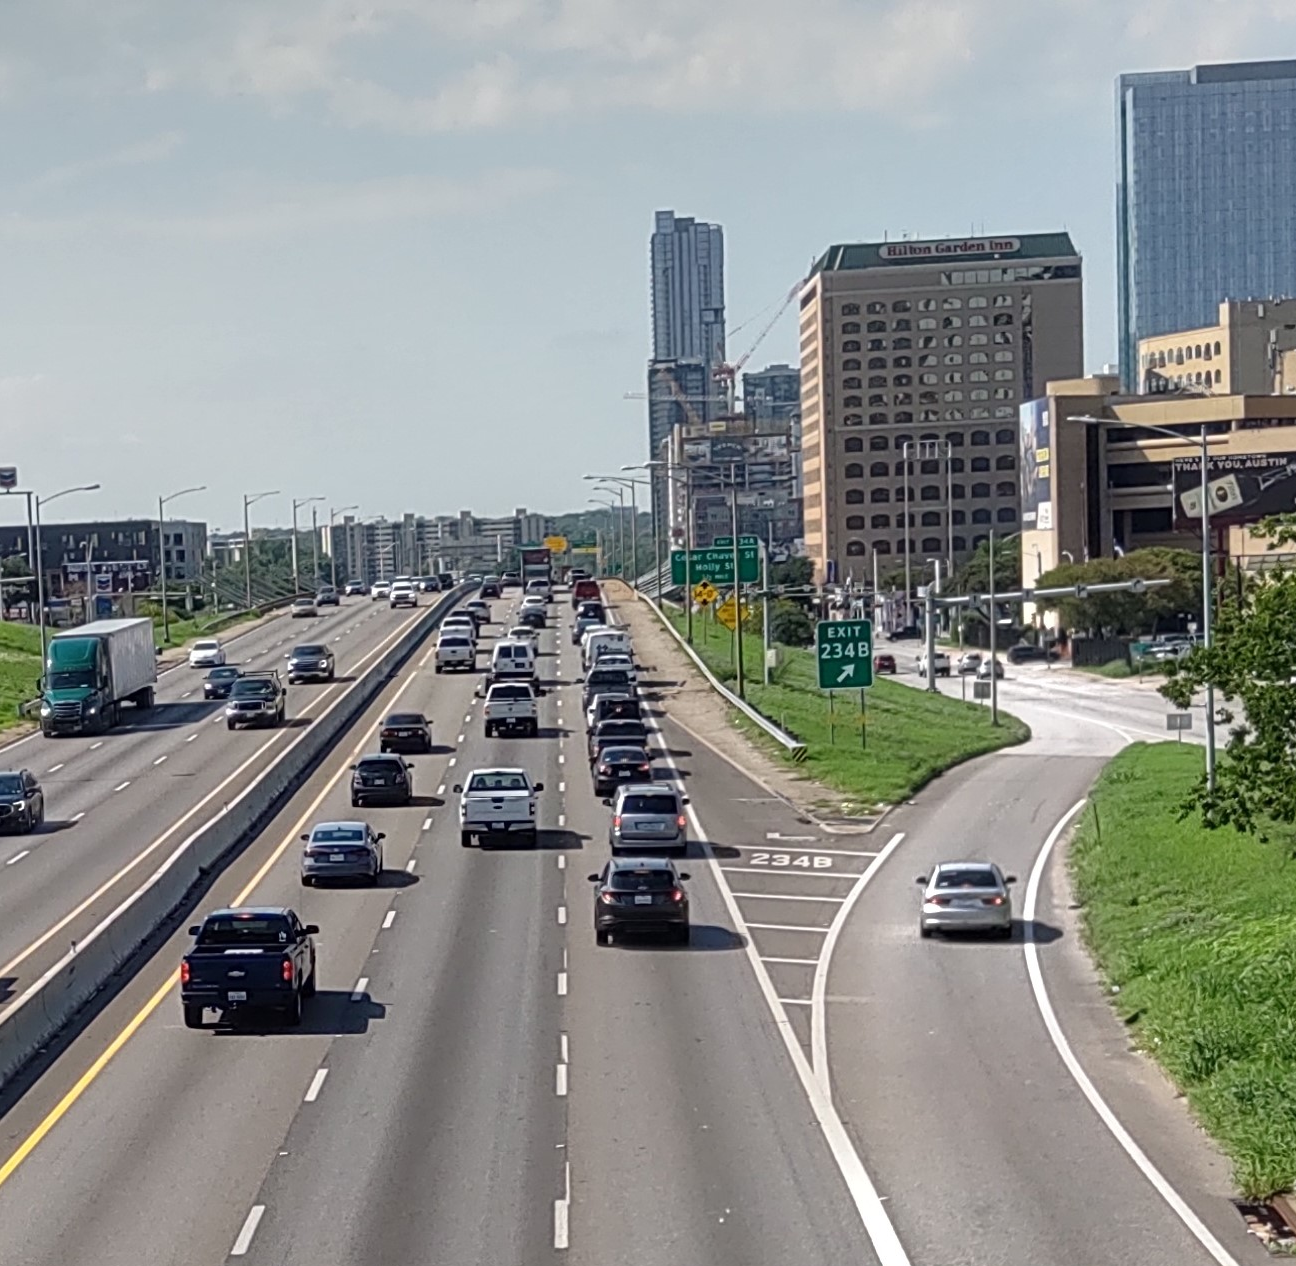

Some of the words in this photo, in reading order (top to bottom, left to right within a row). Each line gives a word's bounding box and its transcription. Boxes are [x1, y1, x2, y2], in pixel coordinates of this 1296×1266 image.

[887, 244, 932, 257] Hilton
[935, 241, 986, 254] Garden
[989, 240, 1014, 251] Inn
[1245, 457, 1288, 468] AUSTIN
[744, 551, 755, 559] St
[695, 562, 720, 572] Holly
[827, 626, 861, 638] EXIT
[820, 641, 870, 659] 234B
[749, 852, 833, 868] 234B
